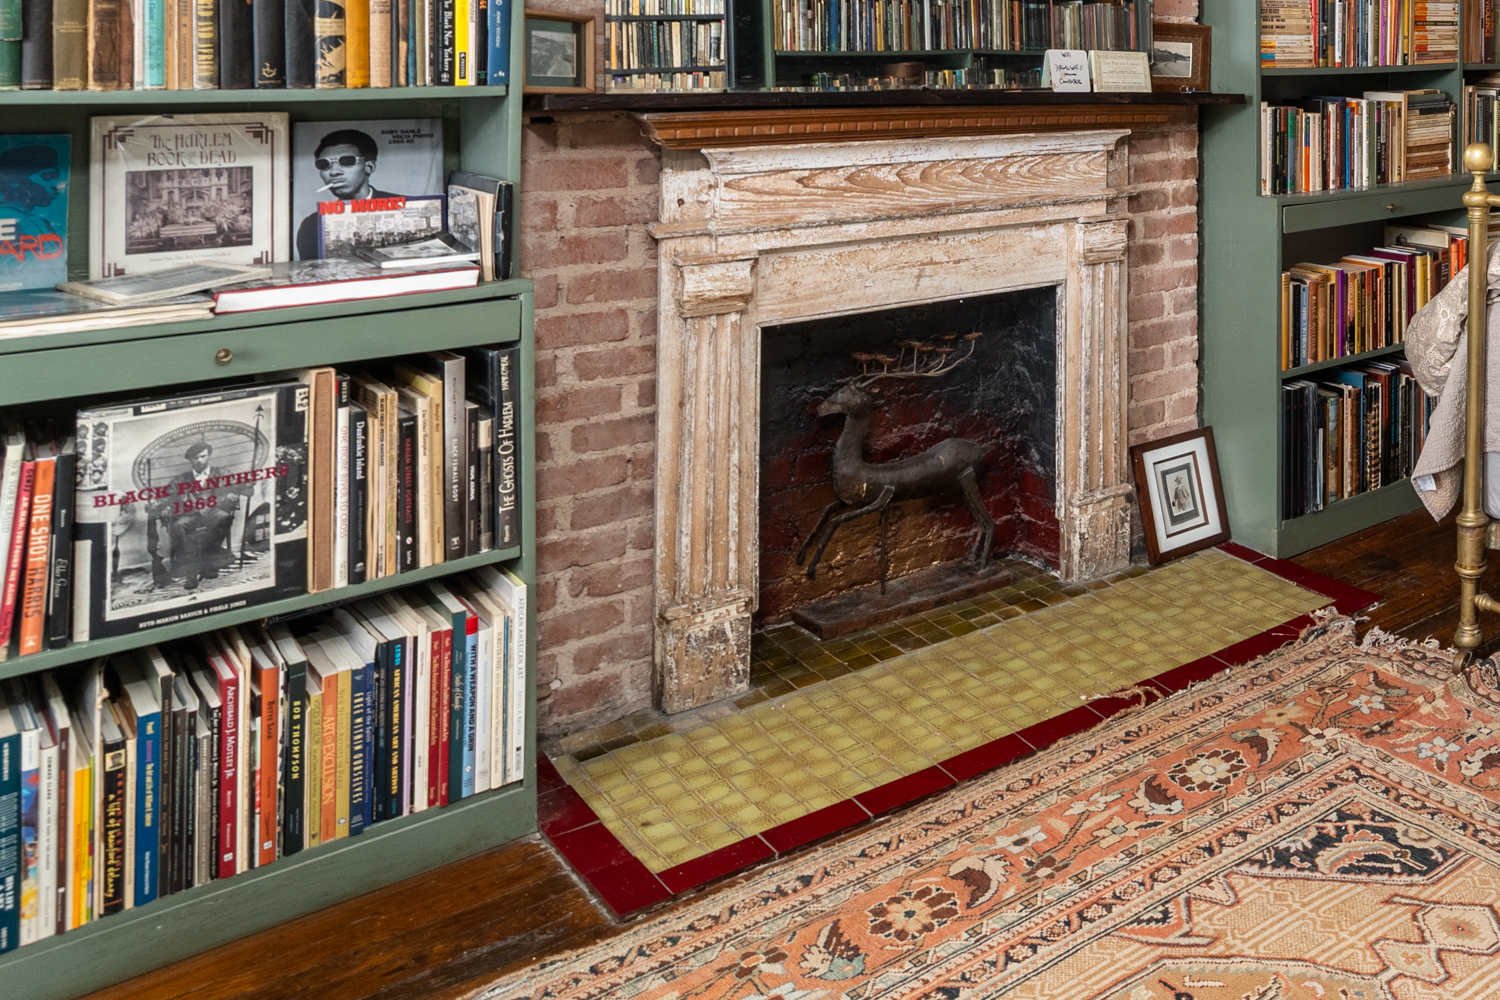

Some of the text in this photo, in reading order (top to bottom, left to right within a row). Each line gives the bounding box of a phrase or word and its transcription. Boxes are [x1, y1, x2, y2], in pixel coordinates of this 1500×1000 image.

[198, 22, 214, 38] AND
[444, 10, 452, 29] Black
[444, 30, 452, 46] New
[444, 47, 452, 72] Yorkers
[148, 152, 186, 166] BOOK
[202, 152, 236, 166] DEAD
[319, 200, 344, 215] NO
[350, 196, 406, 213] MORE!
[356, 422, 364, 480] Daufuskie Island
[498, 402, 514, 514] THE GHOSTS OF HARLEM
[92, 464, 290, 508] BLACK PANTHERS
[172, 495, 218, 516] 1968
[24, 494, 51, 619] ONE SHOT HARRIS
[226, 686, 236, 728] ARCHIBALD
[266, 723, 276, 740] SAAR
[292, 700, 300, 780] BOB THOMPSON
[226, 735, 236, 768] MOTLEY
[352, 692, 363, 804] FREE WITHIN OURSELVES
[226, 769, 236, 780] JR.
[322, 747, 334, 805] EXCLUSION
